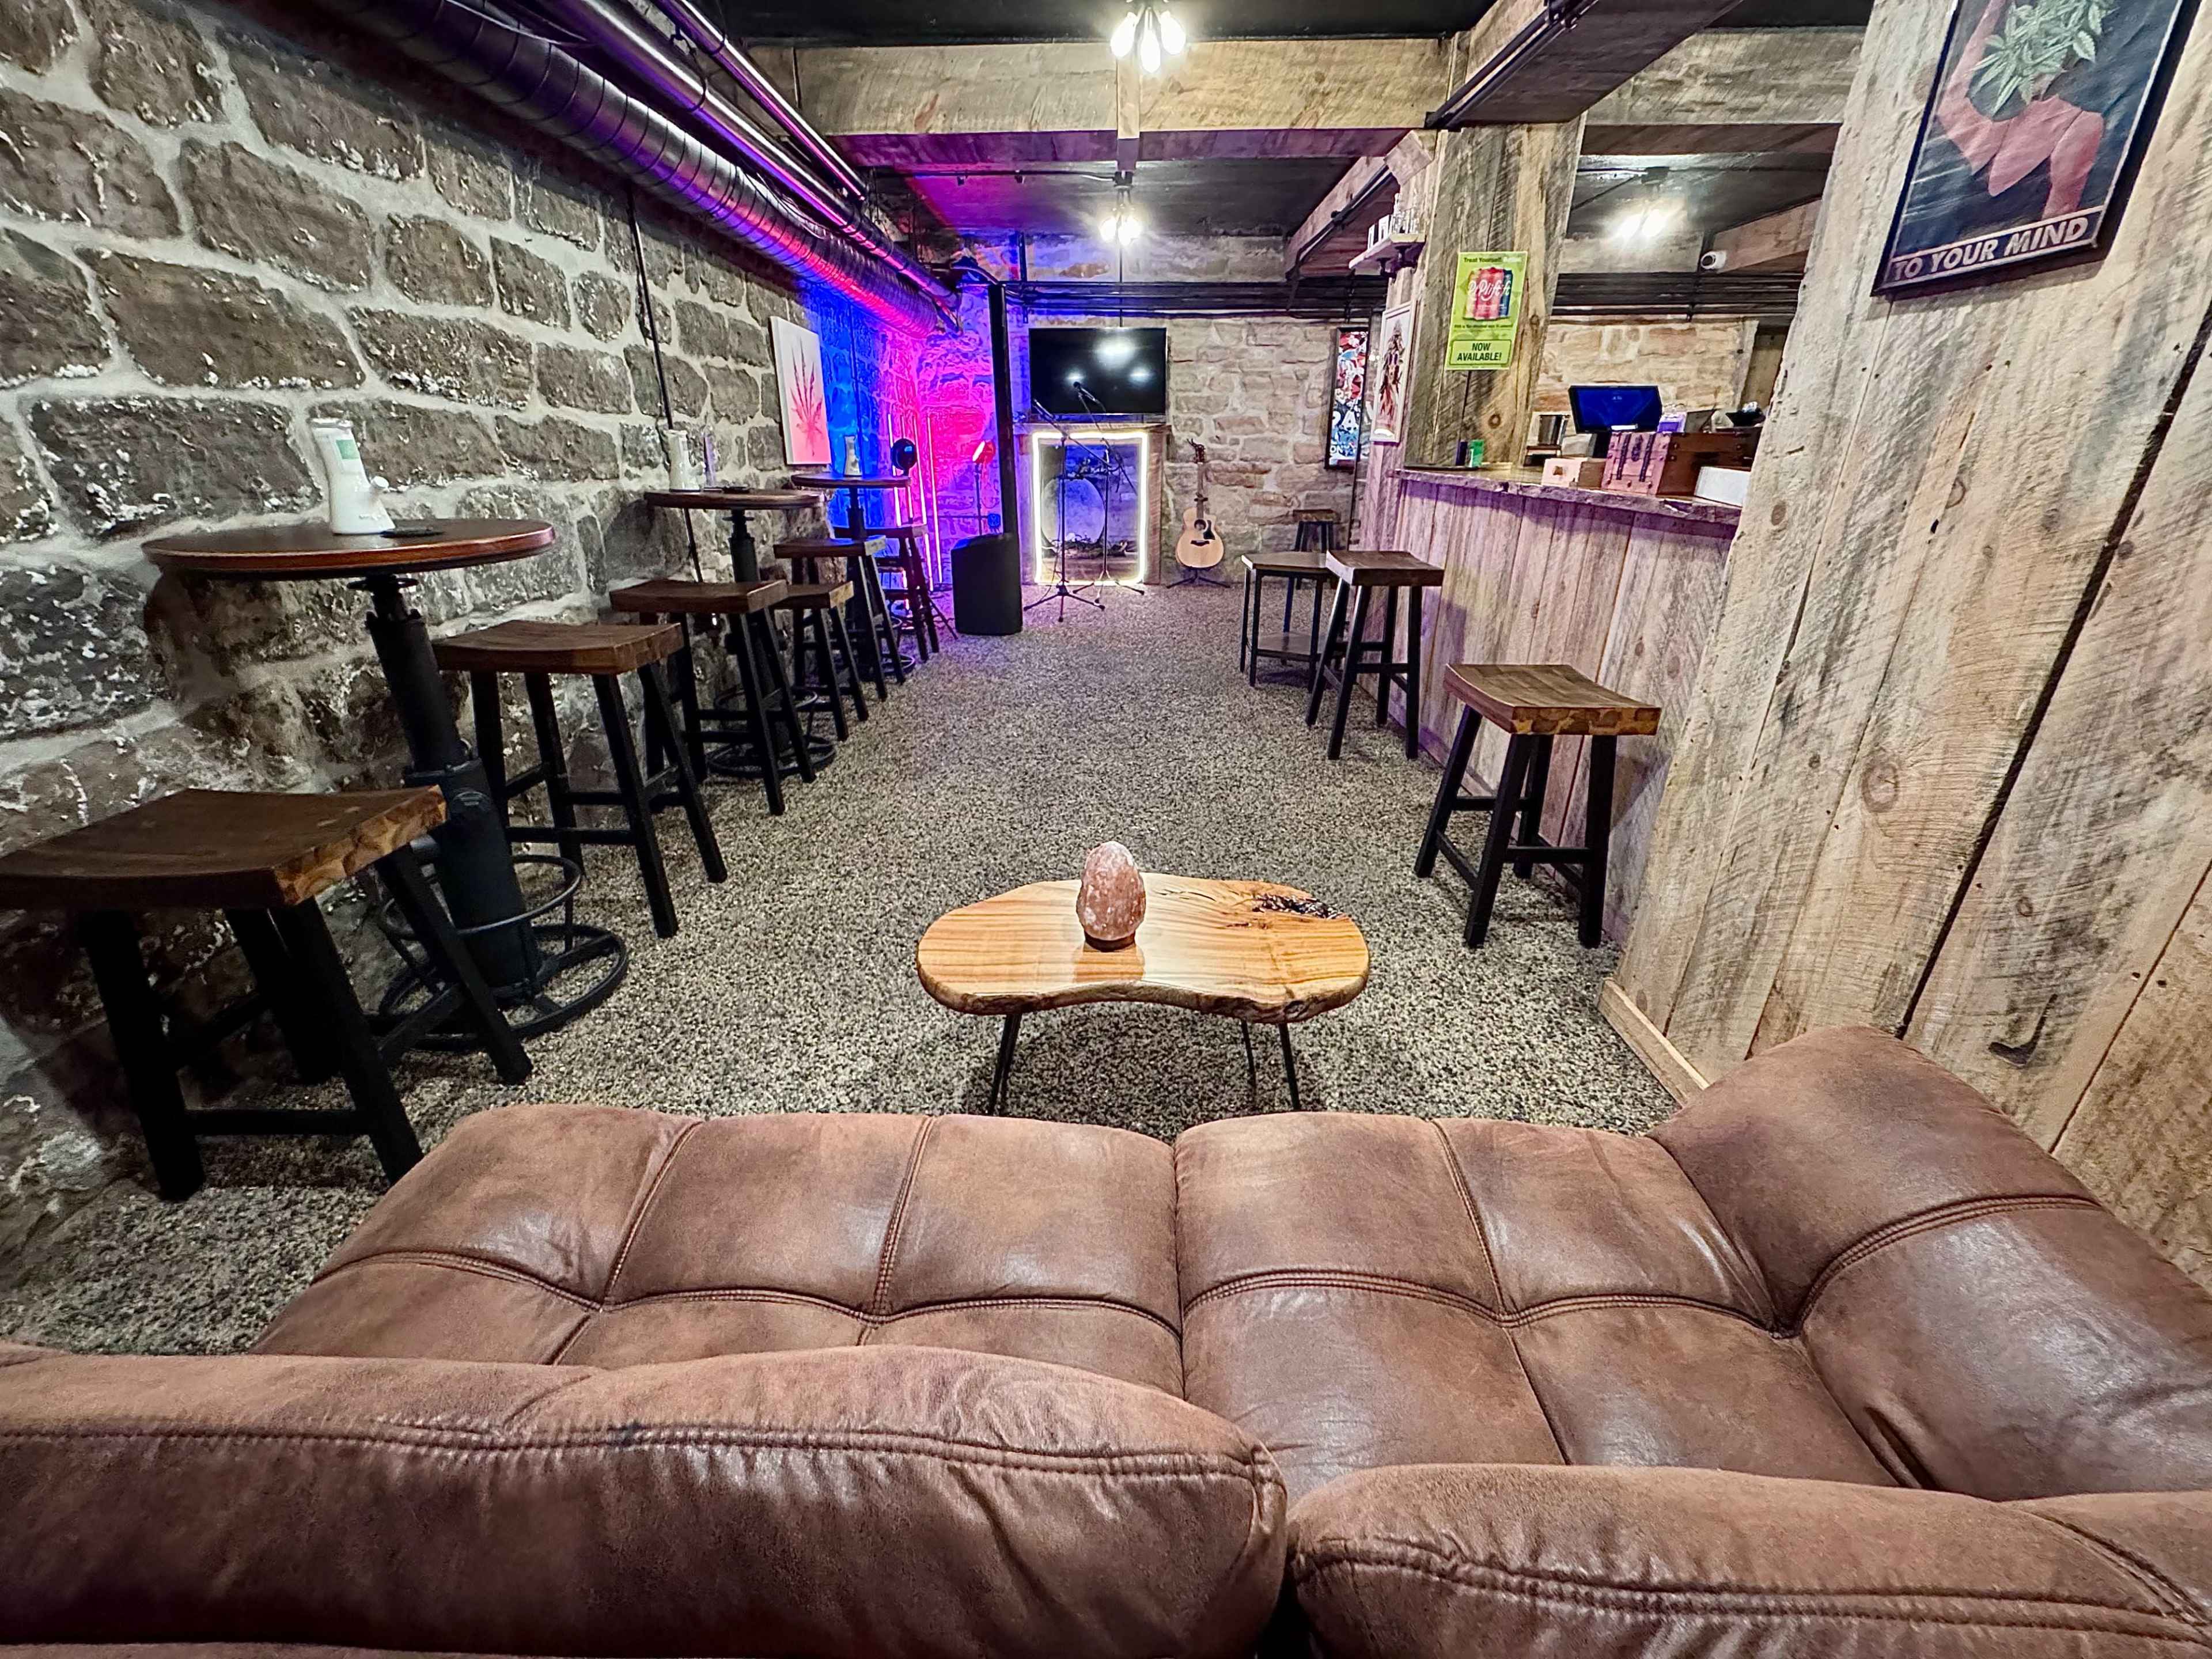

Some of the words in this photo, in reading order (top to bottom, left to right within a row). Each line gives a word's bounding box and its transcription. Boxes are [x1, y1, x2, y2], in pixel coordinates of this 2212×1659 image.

[1893, 257, 1923, 280] TO
[1930, 238, 1998, 272] YOUR
[2003, 217, 2088, 257] MIND
[1472, 343, 1491, 351] NOW
[1457, 352, 1502, 361] AVAILABLE!
